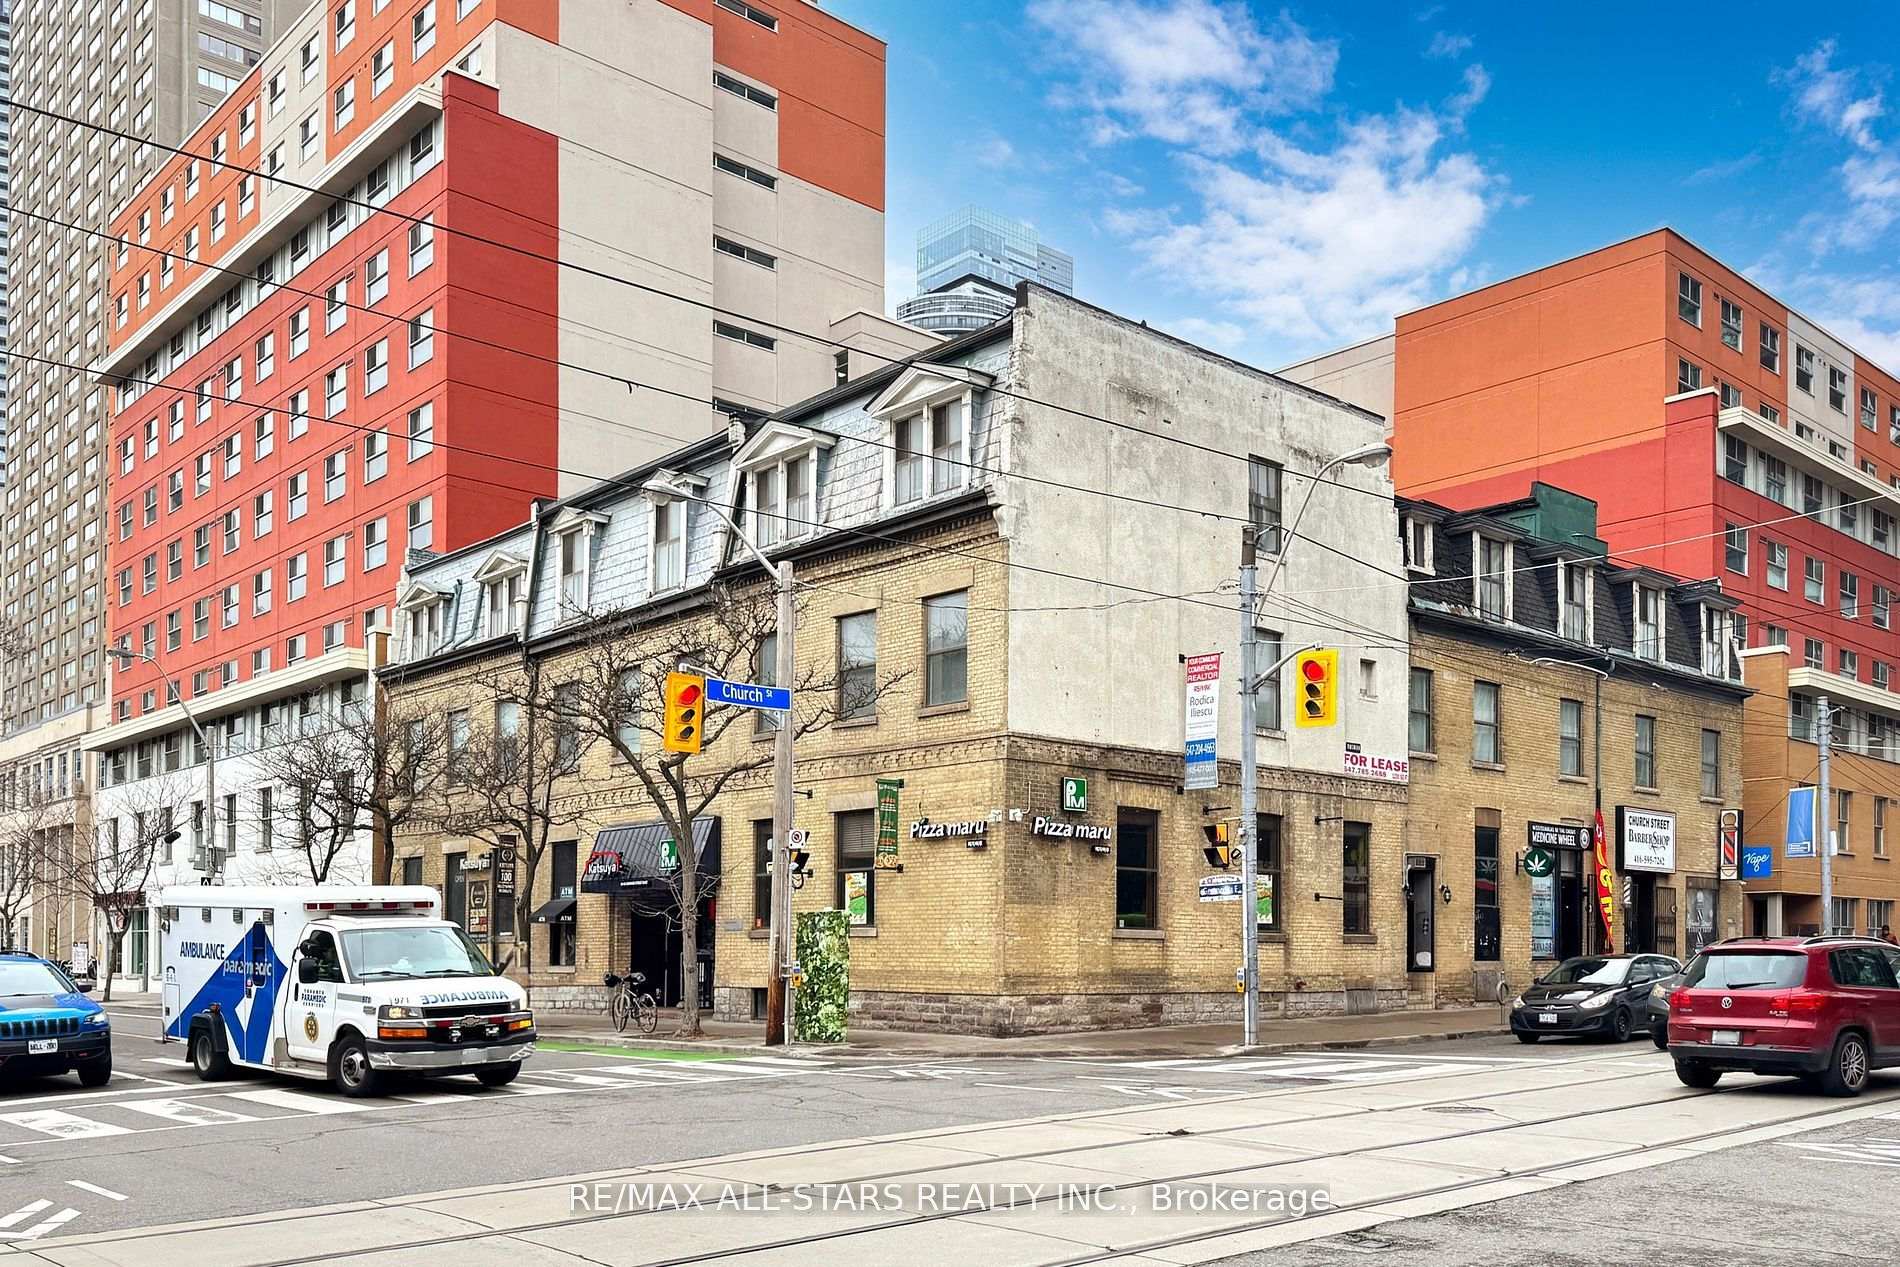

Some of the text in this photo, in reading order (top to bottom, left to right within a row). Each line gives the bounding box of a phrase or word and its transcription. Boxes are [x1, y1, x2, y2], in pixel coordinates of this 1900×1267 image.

[1187, 671, 1218, 682] REALTOR
[722, 683, 763, 703] Church
[1190, 695, 1214, 706] Rodica
[1344, 754, 1408, 773] FOR LEASE
[910, 819, 944, 838] Pizza
[946, 821, 984, 836] maru
[1033, 816, 1112, 839] Pizza maru
[1628, 815, 1670, 831] CHURCH STREET
[1532, 830, 1577, 846] MEDICINE WHEEL
[1743, 852, 1769, 873] Vape
[180, 941, 225, 960] AMBULANCE
[222, 959, 272, 977] paramedic
[301, 993, 327, 1003] PARAMEDIC
